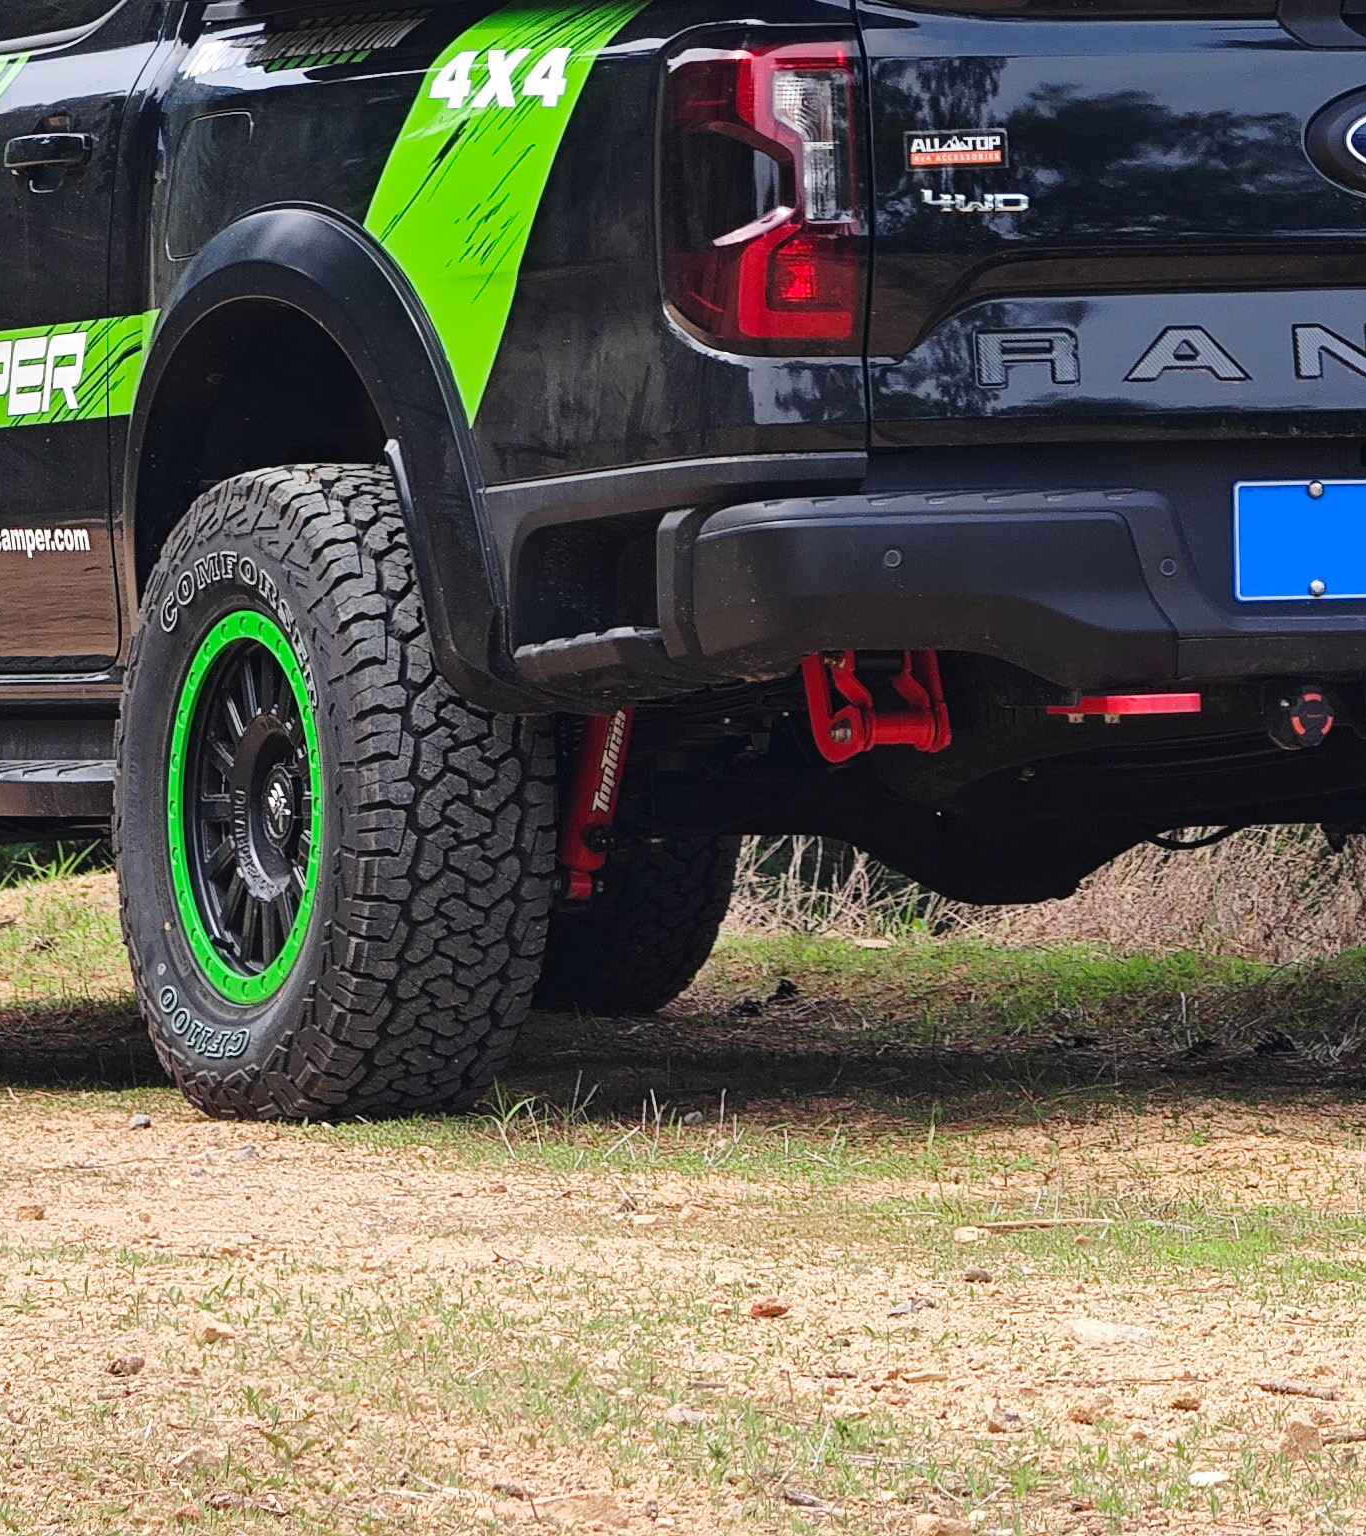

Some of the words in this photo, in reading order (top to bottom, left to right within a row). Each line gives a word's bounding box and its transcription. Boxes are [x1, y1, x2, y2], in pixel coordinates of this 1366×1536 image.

[429, 47, 572, 109] 4X4
[921, 188, 1029, 212] 4WD
[160, 551, 319, 708] COMFORSER
[160, 985, 251, 1058] CF1100
